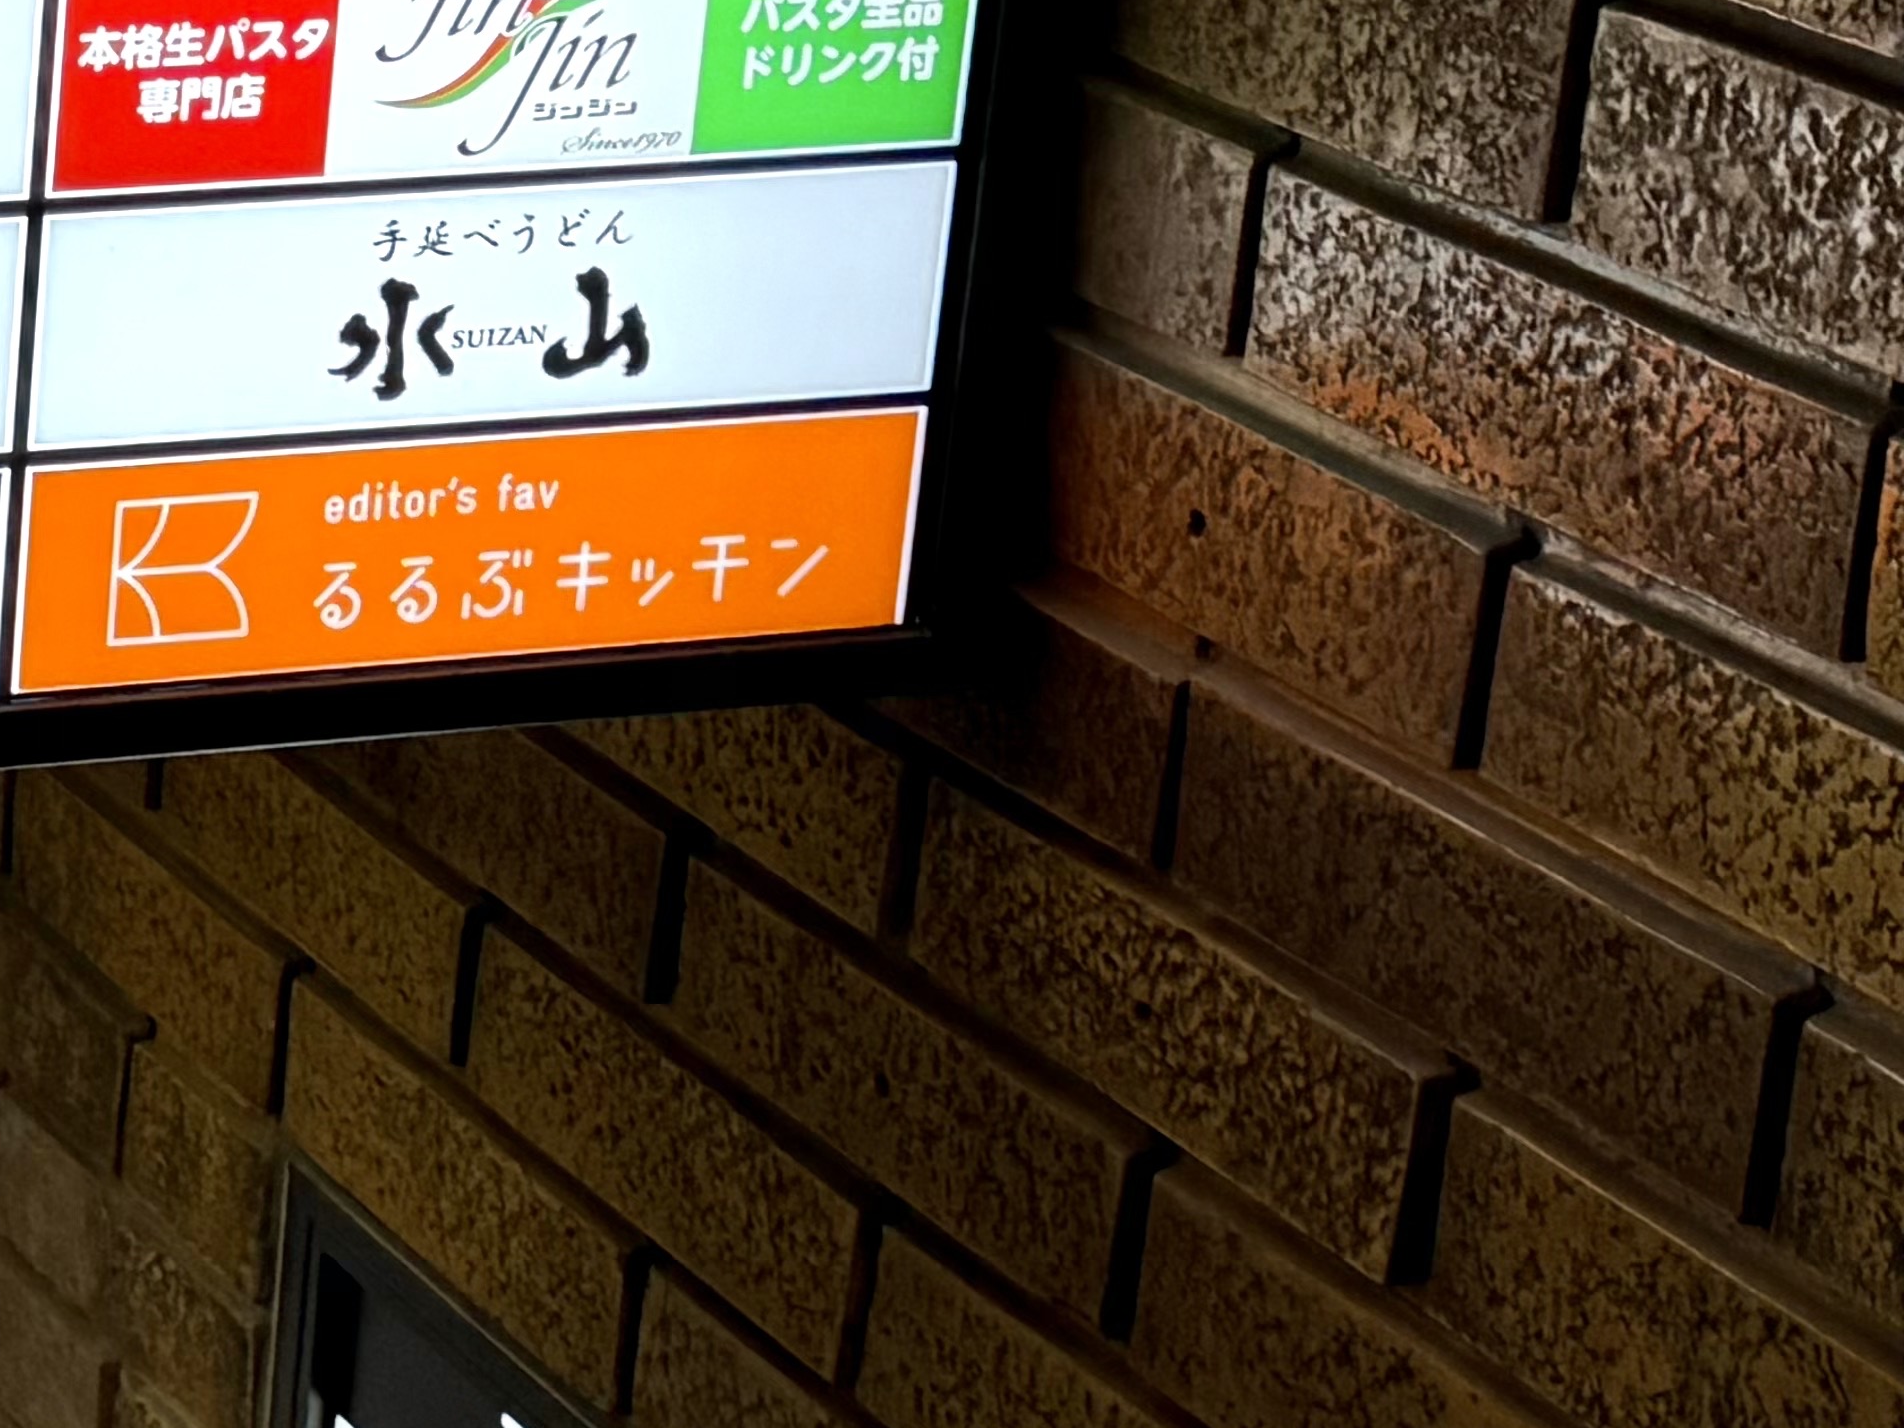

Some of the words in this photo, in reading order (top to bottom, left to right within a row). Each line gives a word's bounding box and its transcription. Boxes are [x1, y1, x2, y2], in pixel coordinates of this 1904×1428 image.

[78, 19, 330, 73] 本格生パスタ
[742, 34, 940, 90] ドリンク付
[137, 75, 265, 123] 専門店
[528, 96, 642, 124] ジンジン
[372, 208, 631, 263] 手延べうどん
[451, 324, 547, 350] SUIZAN
[497, 472, 560, 512] fav
[313, 534, 829, 630] るるぶキッチン
